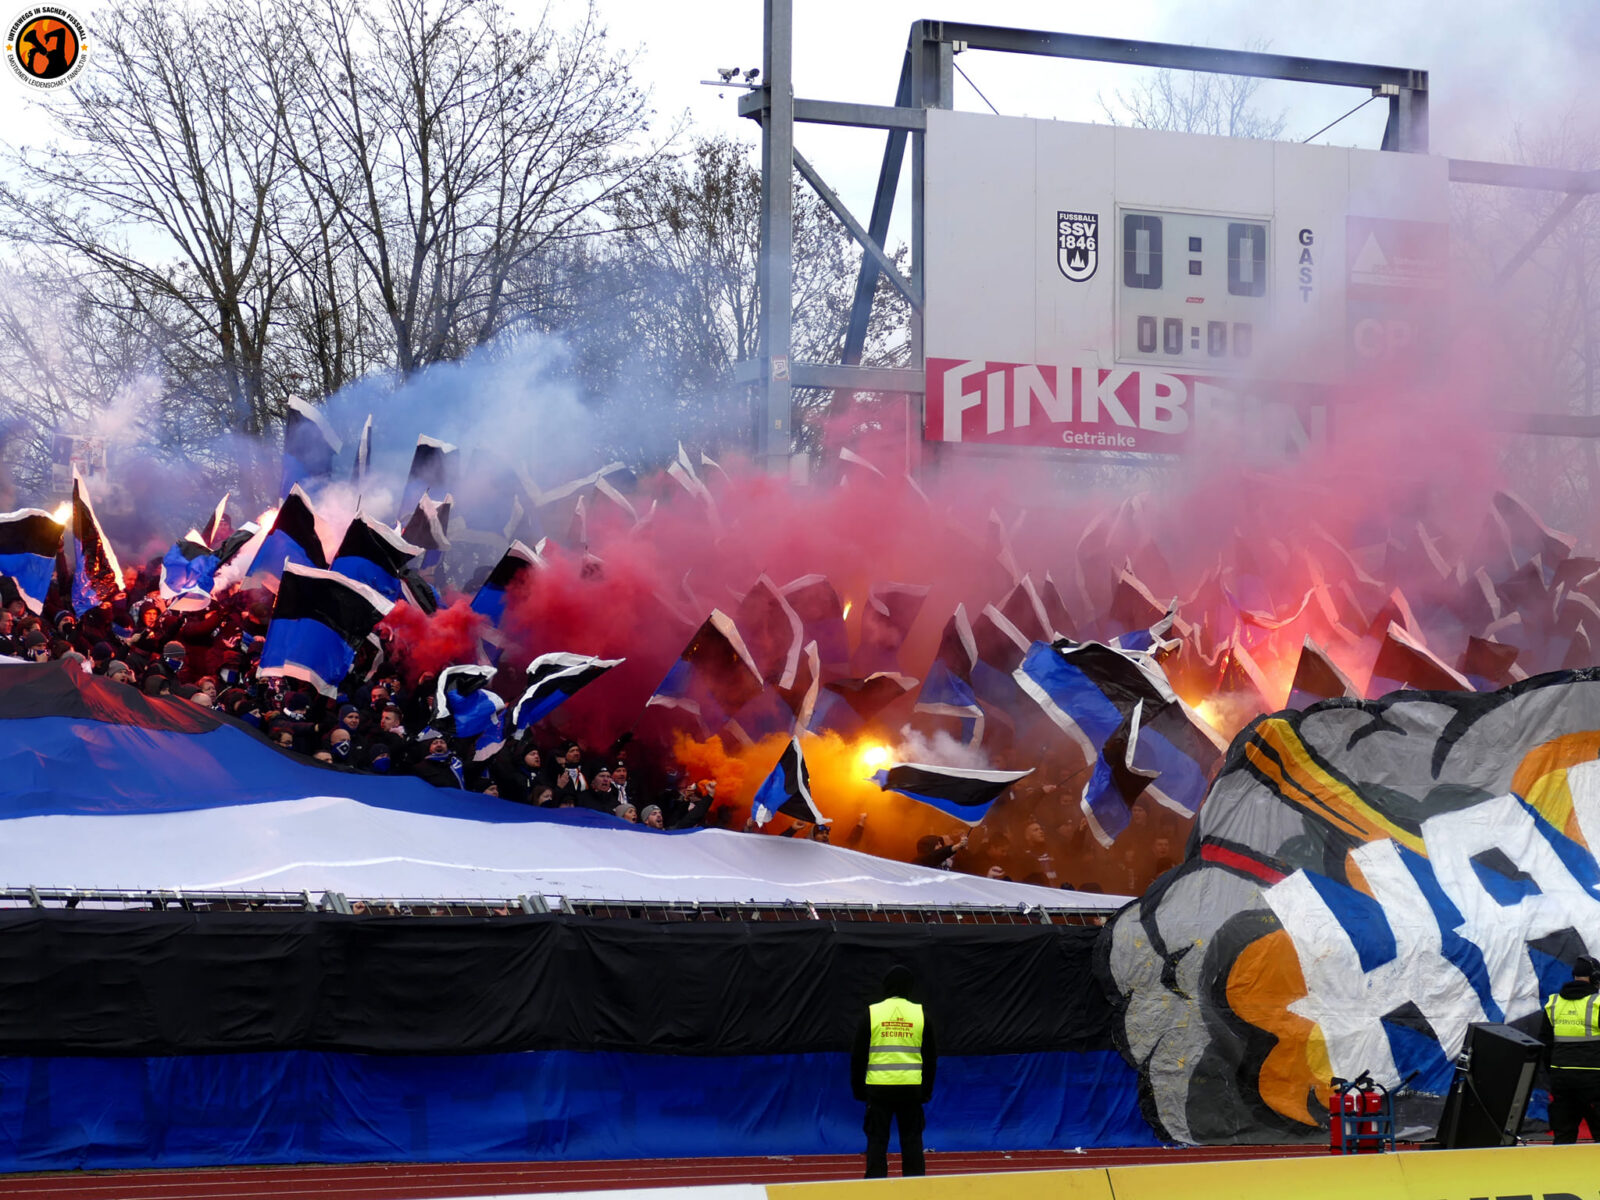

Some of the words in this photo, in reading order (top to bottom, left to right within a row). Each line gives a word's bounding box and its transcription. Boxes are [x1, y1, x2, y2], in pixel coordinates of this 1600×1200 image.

[1060, 213, 1096, 222] FUSSBALL
[1059, 221, 1096, 237] SSV
[1059, 234, 1096, 251] 1846
[1298, 228, 1314, 303] GAST
[1062, 430, 1136, 447] Getränke
